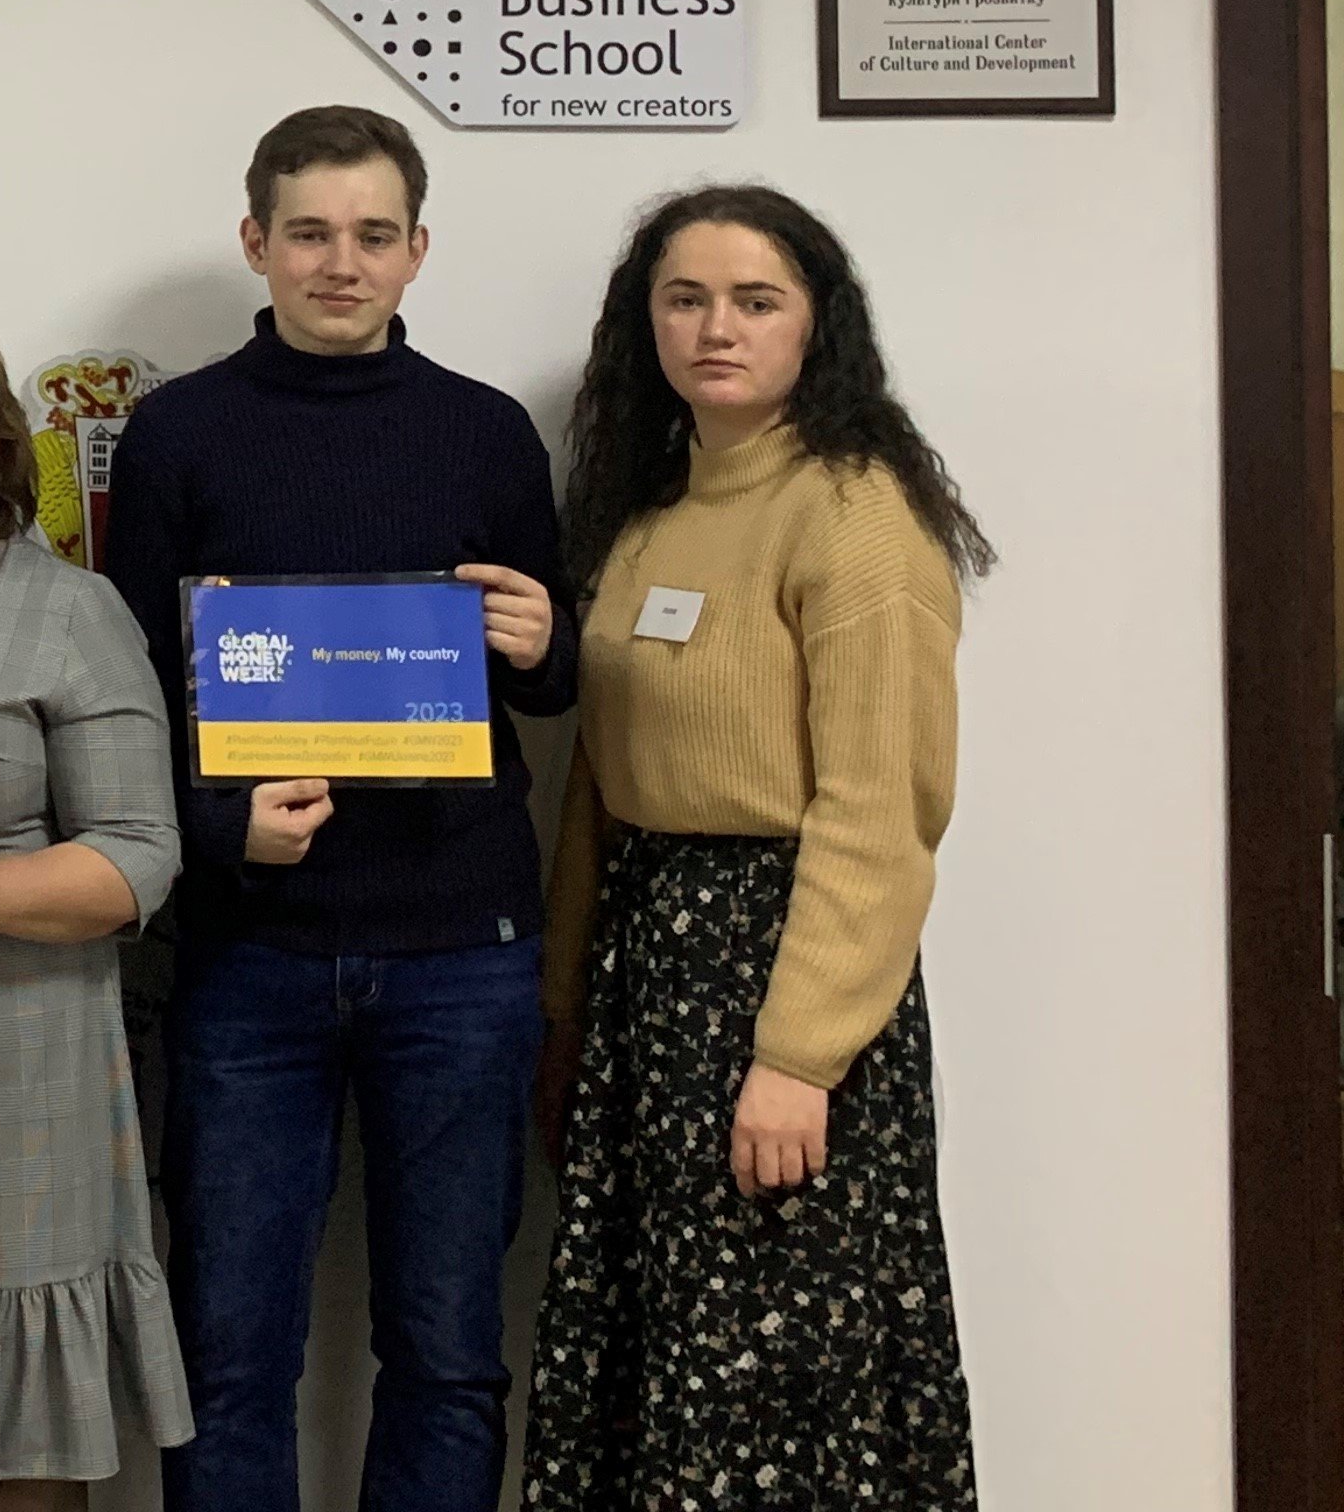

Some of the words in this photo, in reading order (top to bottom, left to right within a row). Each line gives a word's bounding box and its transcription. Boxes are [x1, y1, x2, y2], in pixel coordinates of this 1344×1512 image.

[888, 34, 989, 51] International
[995, 34, 1047, 49] Center
[499, 29, 682, 77] School
[859, 56, 877, 71] of
[880, 55, 939, 71] Culture
[943, 55, 970, 70] and
[976, 54, 1076, 72] Development
[501, 94, 541, 118] for
[551, 98, 607, 118] new
[617, 95, 732, 118] creators
[217, 632, 294, 651] GLOBAL
[219, 650, 287, 666] MONEY
[312, 648, 332, 664] My
[335, 651, 383, 664] money.
[386, 648, 405, 664] My
[409, 648, 460, 664] country
[220, 666, 277, 683] WEEK
[404, 702, 464, 721] 2023
